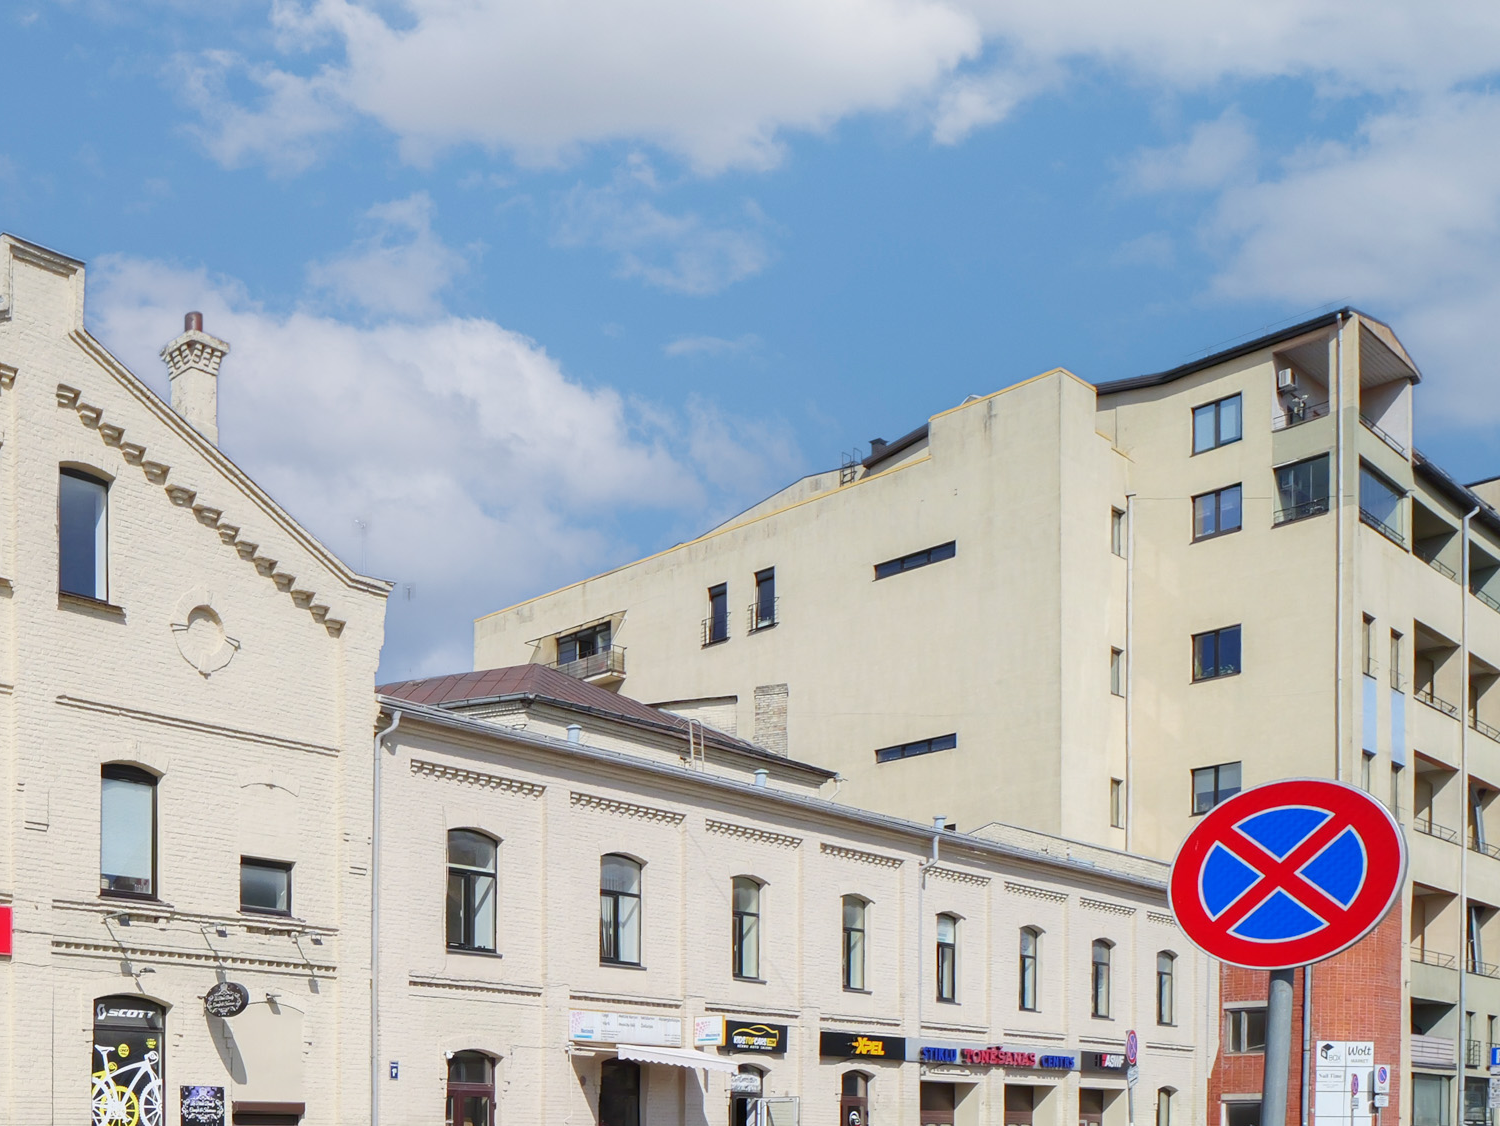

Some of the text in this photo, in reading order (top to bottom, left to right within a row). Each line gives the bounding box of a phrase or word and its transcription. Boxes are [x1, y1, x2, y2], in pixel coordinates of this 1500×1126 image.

[107, 1008, 156, 1018] SCOTT
[855, 1037, 885, 1055] XPEL
[1348, 1046, 1372, 1056] Wolt
[1040, 1055, 1075, 1068] CENTRS
